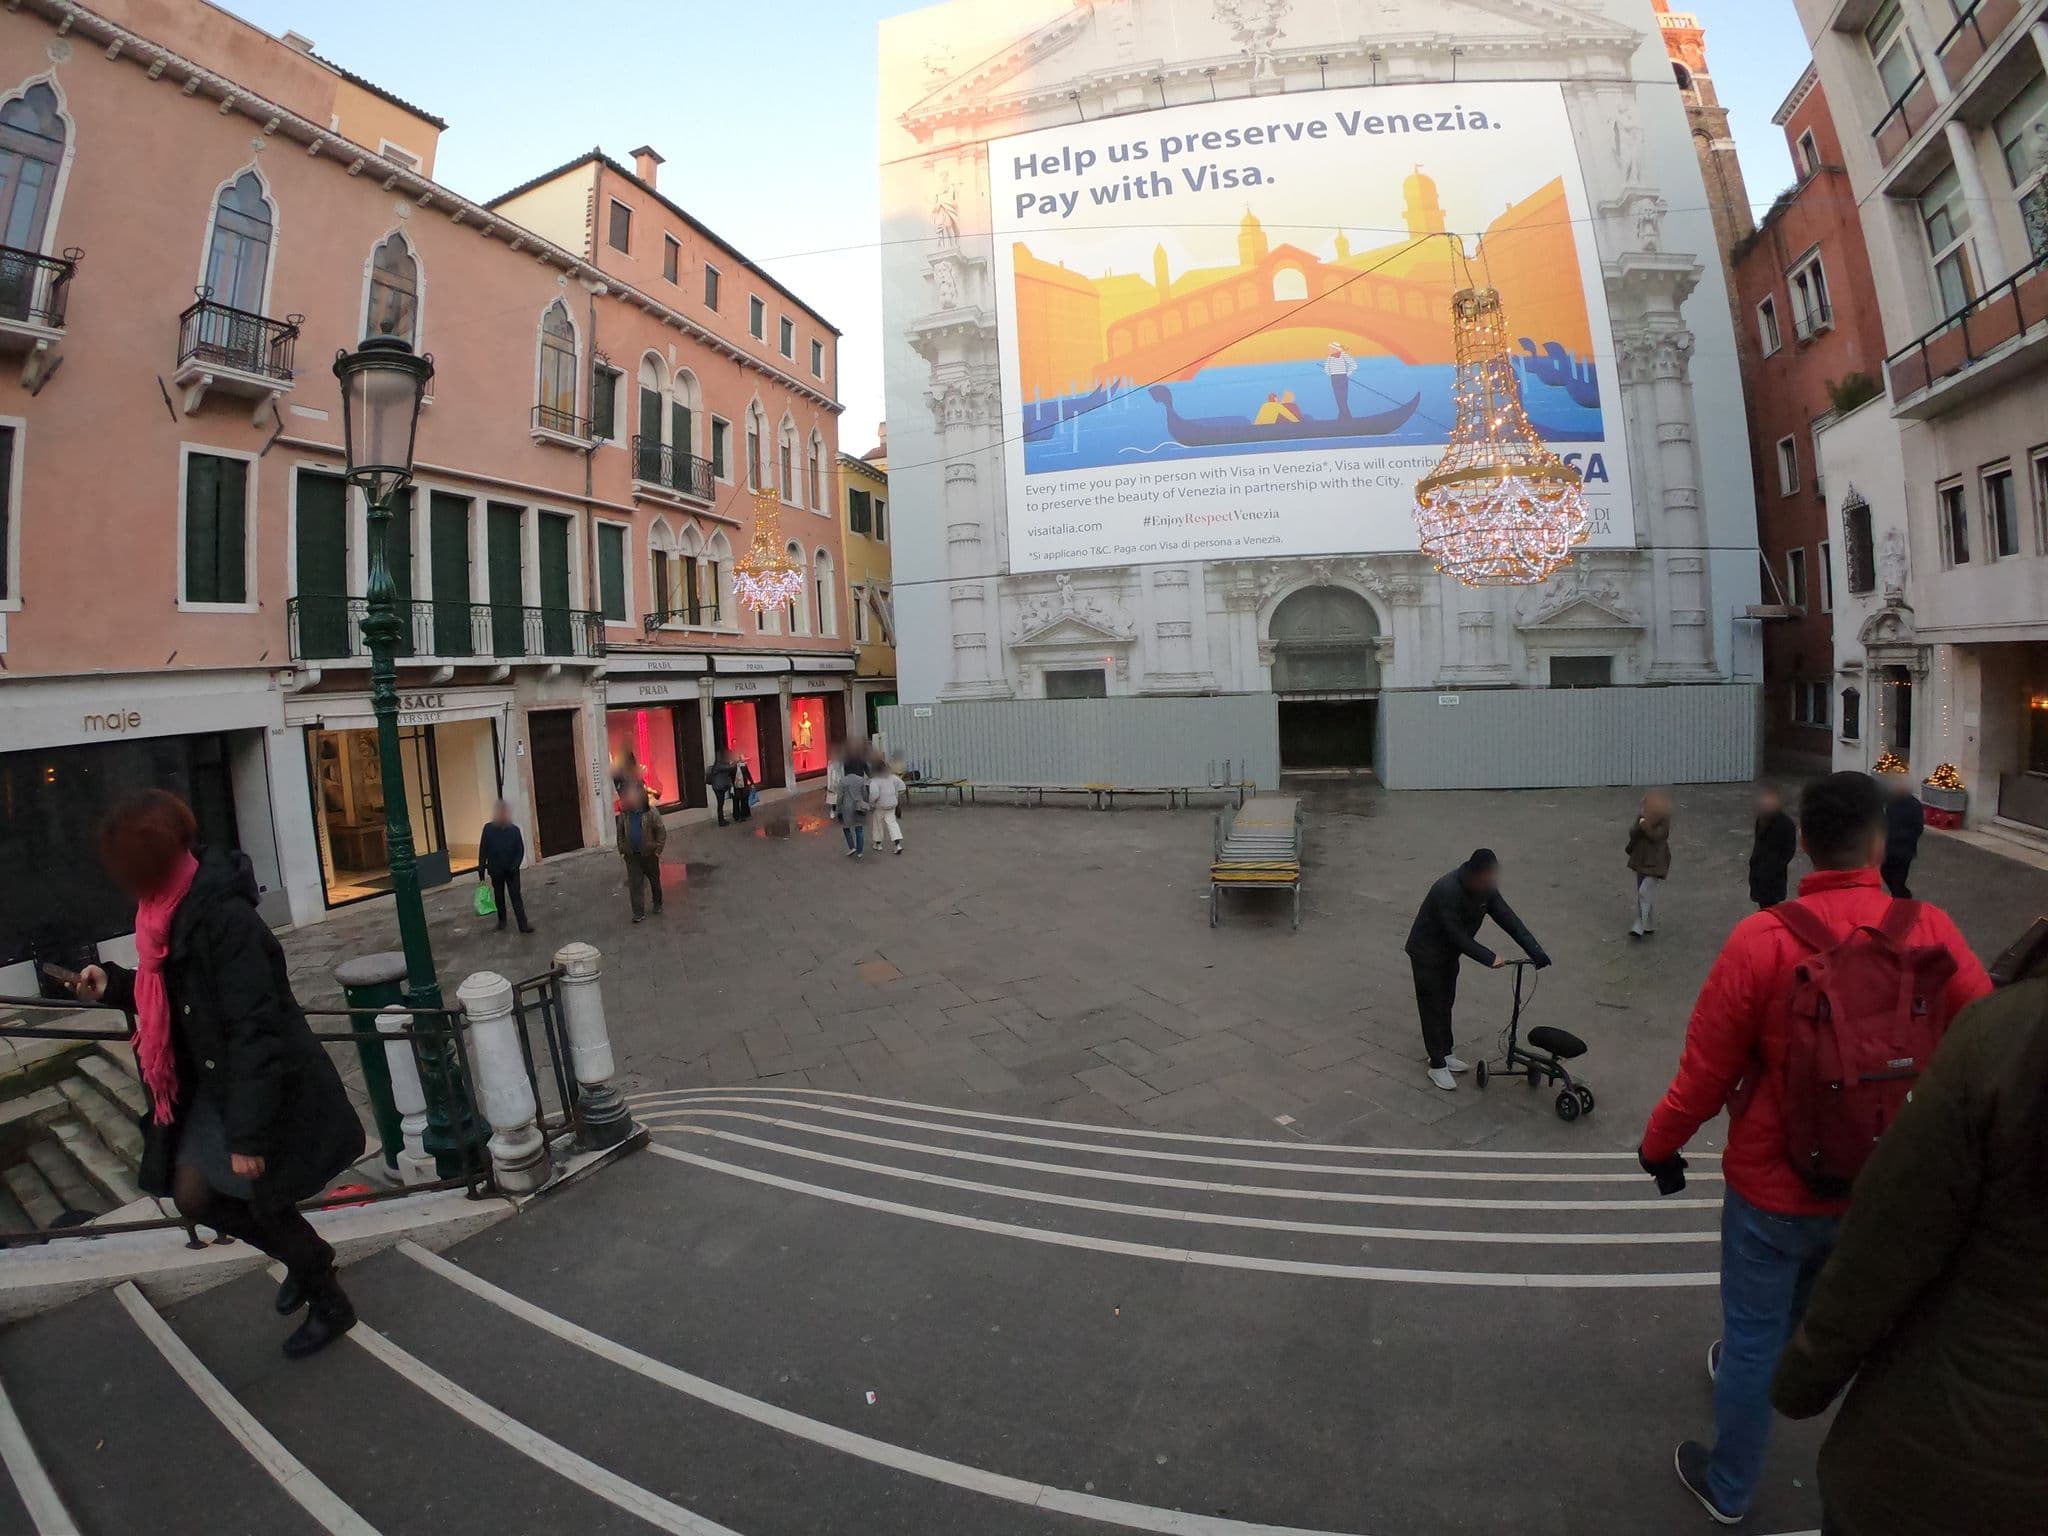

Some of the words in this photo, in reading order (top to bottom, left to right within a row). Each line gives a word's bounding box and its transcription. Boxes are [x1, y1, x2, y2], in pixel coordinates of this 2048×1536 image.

[1013, 145, 1096, 180] Help
[1107, 139, 1149, 163] us
[1160, 118, 1328, 163] preserve
[1336, 104, 1503, 137] Venezia.
[1015, 188, 1079, 219] Pay
[1090, 170, 1173, 206] with
[1182, 164, 1276, 193] Visa.
[1025, 483, 1057, 496] Every
[1060, 479, 1087, 492] time
[1089, 478, 1112, 490] you
[1115, 476, 1137, 489] pay
[1140, 473, 1151, 485] in
[1154, 471, 1197, 488] person
[1199, 467, 1228, 480] with
[1230, 465, 1256, 478] Visa
[1259, 464, 1270, 476] in
[1334, 459, 1360, 471] Visa
[1363, 457, 1385, 470] will
[1027, 502, 1039, 513] to
[1042, 496, 1092, 513] preserve
[1095, 493, 1115, 505] the
[1117, 488, 1159, 504] beauty
[1162, 487, 1177, 500] of
[1177, 484, 1227, 499] Venezia
[1229, 483, 1241, 495] in
[1244, 477, 1318, 497] partnership
[1320, 476, 1349, 490] with
[1352, 475, 1373, 488] the
[1375, 474, 1404, 490] City.
[1594, 508, 1610, 521] DI
[1027, 521, 1103, 537] visaitalia.com
[1043, 547, 1088, 561] applicano
[1114, 544, 1137, 556] Paga
[1139, 542, 1157, 552] con
[1159, 540, 1178, 550] Visa
[1180, 538, 1191, 549] di
[1193, 537, 1232, 550] persona
[1243, 534, 1284, 546] Venezia.
[647, 661, 672, 671] PRADA
[639, 683, 669, 696] PRADA
[734, 681, 757, 692] PRADA
[807, 679, 826, 689] PRADA
[83, 708, 142, 733] maje
